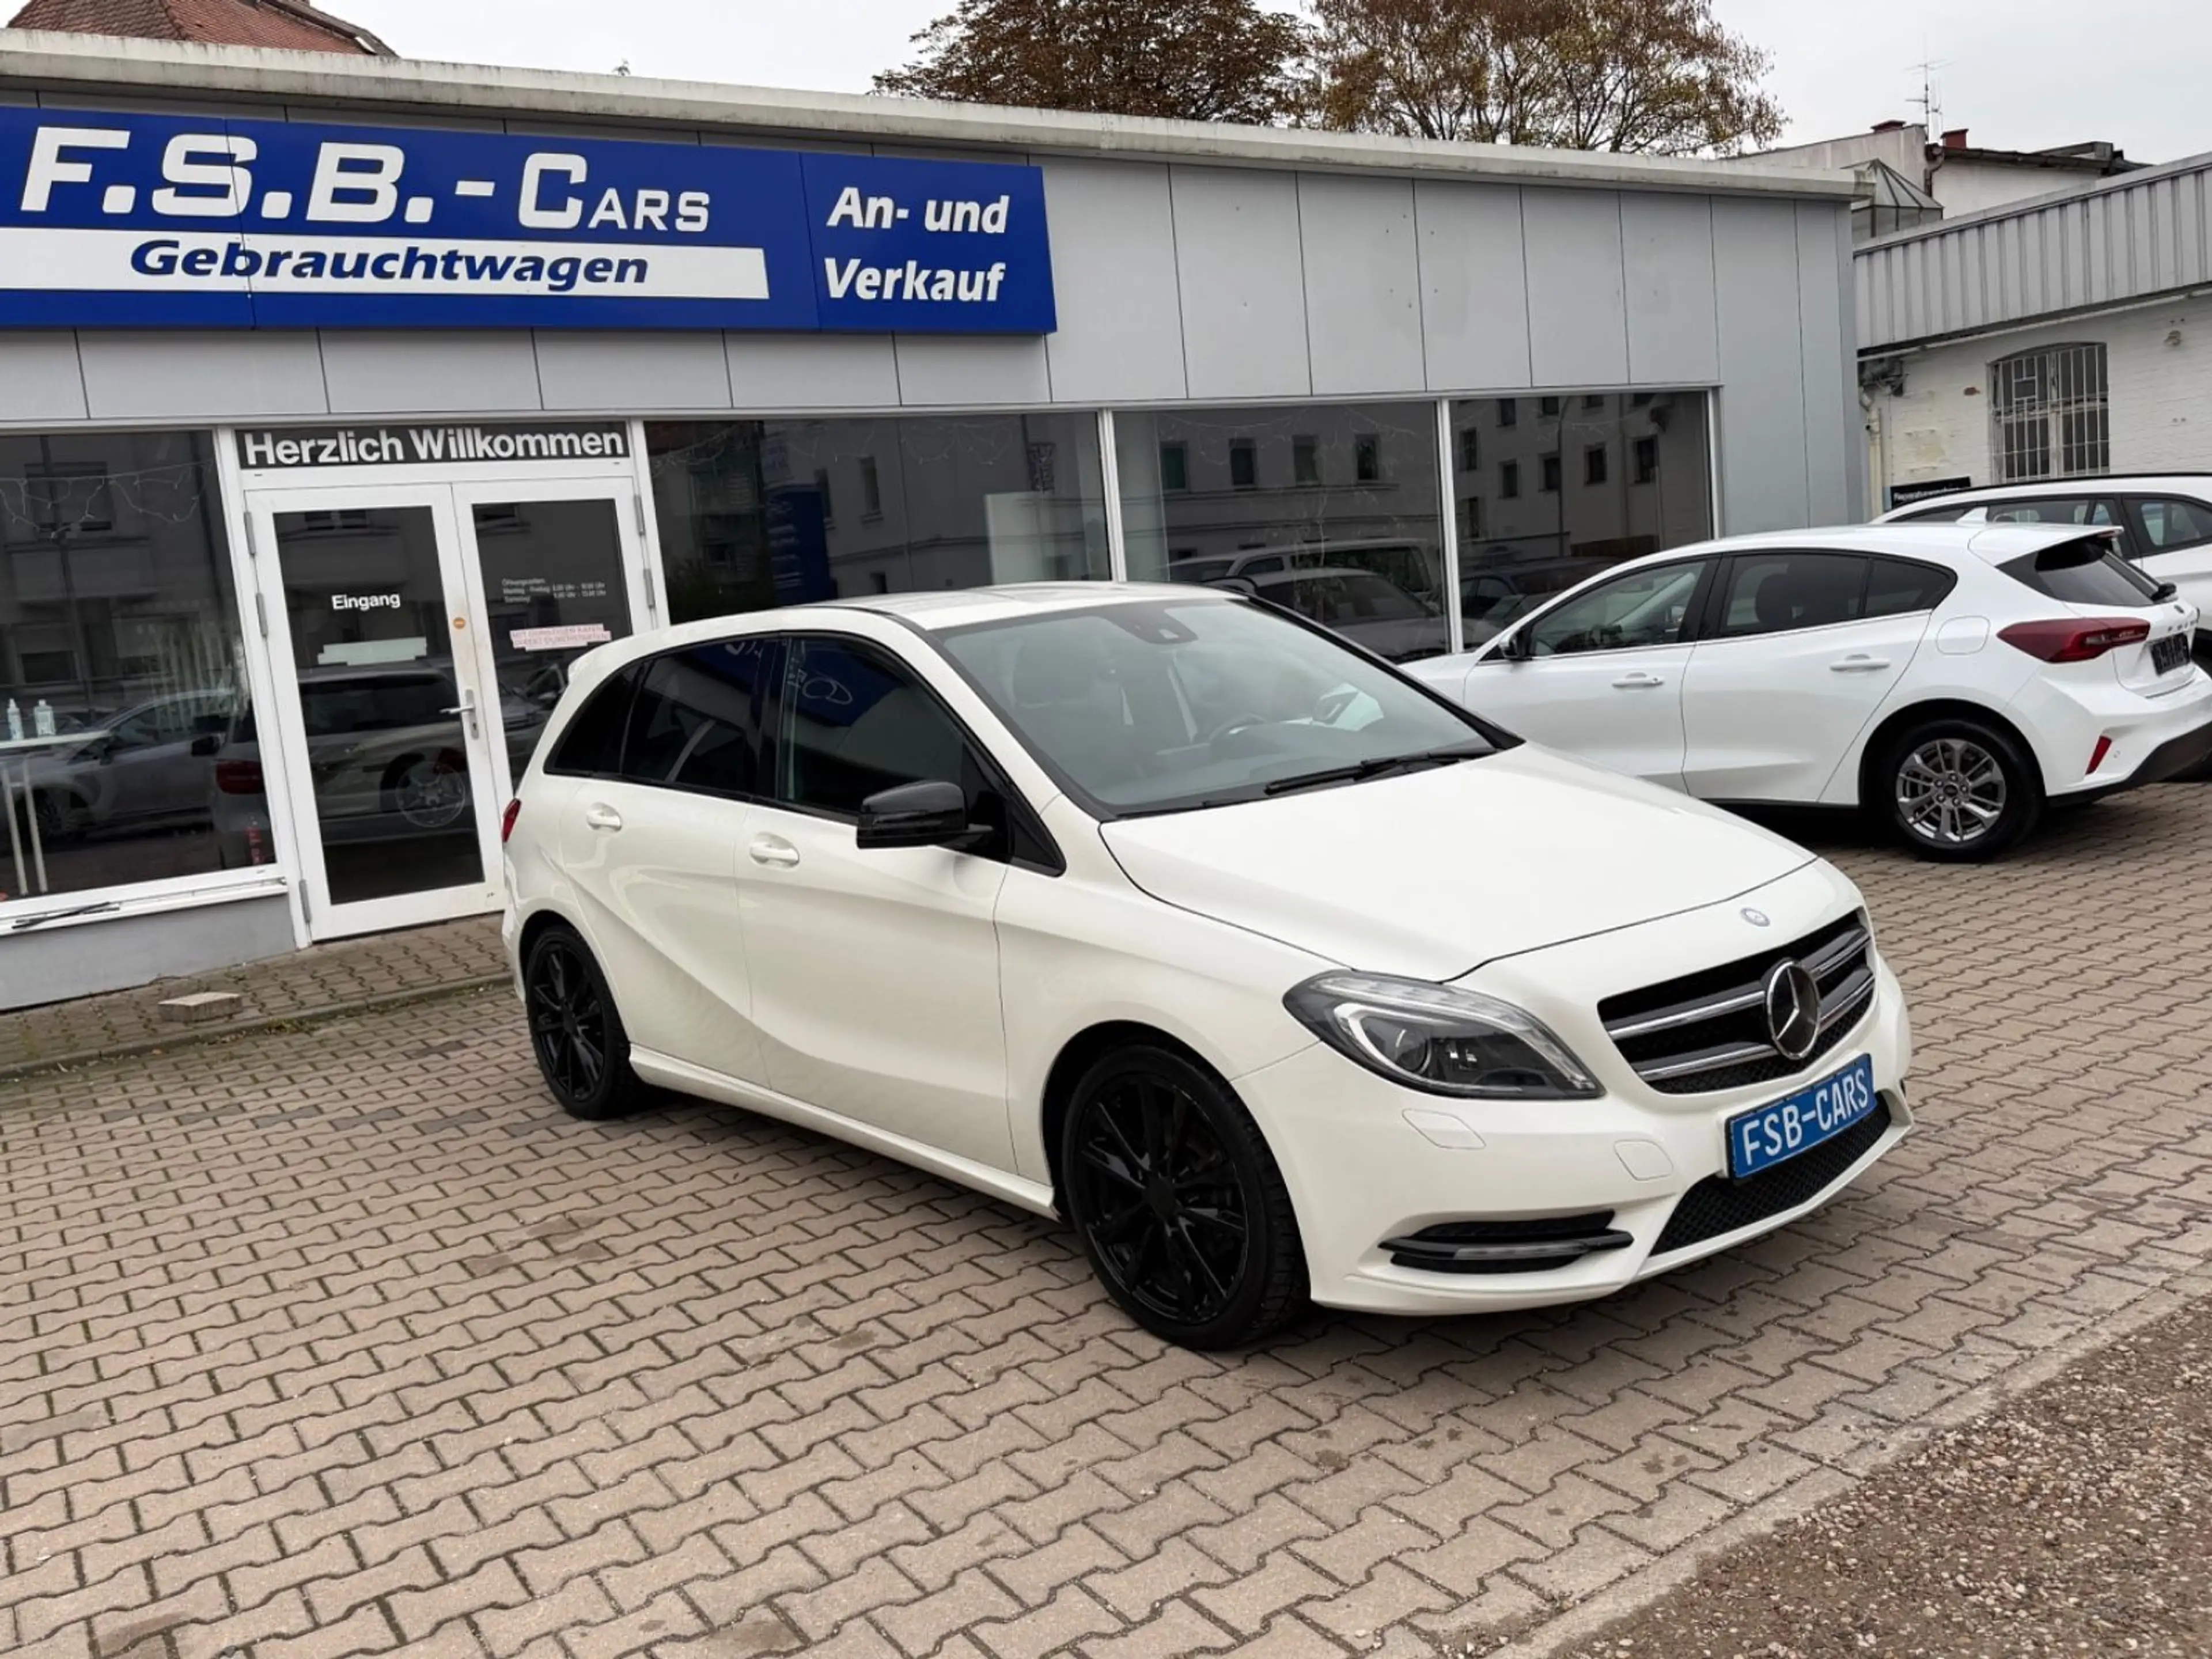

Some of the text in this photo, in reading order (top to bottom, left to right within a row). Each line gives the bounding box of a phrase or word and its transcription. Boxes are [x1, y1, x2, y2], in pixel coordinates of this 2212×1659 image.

[826, 187, 1010, 233] An- und
[131, 240, 648, 292] Gebrauchtwagen
[824, 257, 1006, 301] Verkauf
[245, 429, 624, 465] Herzlich Willkommen
[331, 593, 401, 611] Eingang
[1743, 1069, 1868, 1165] FSB-CARS
